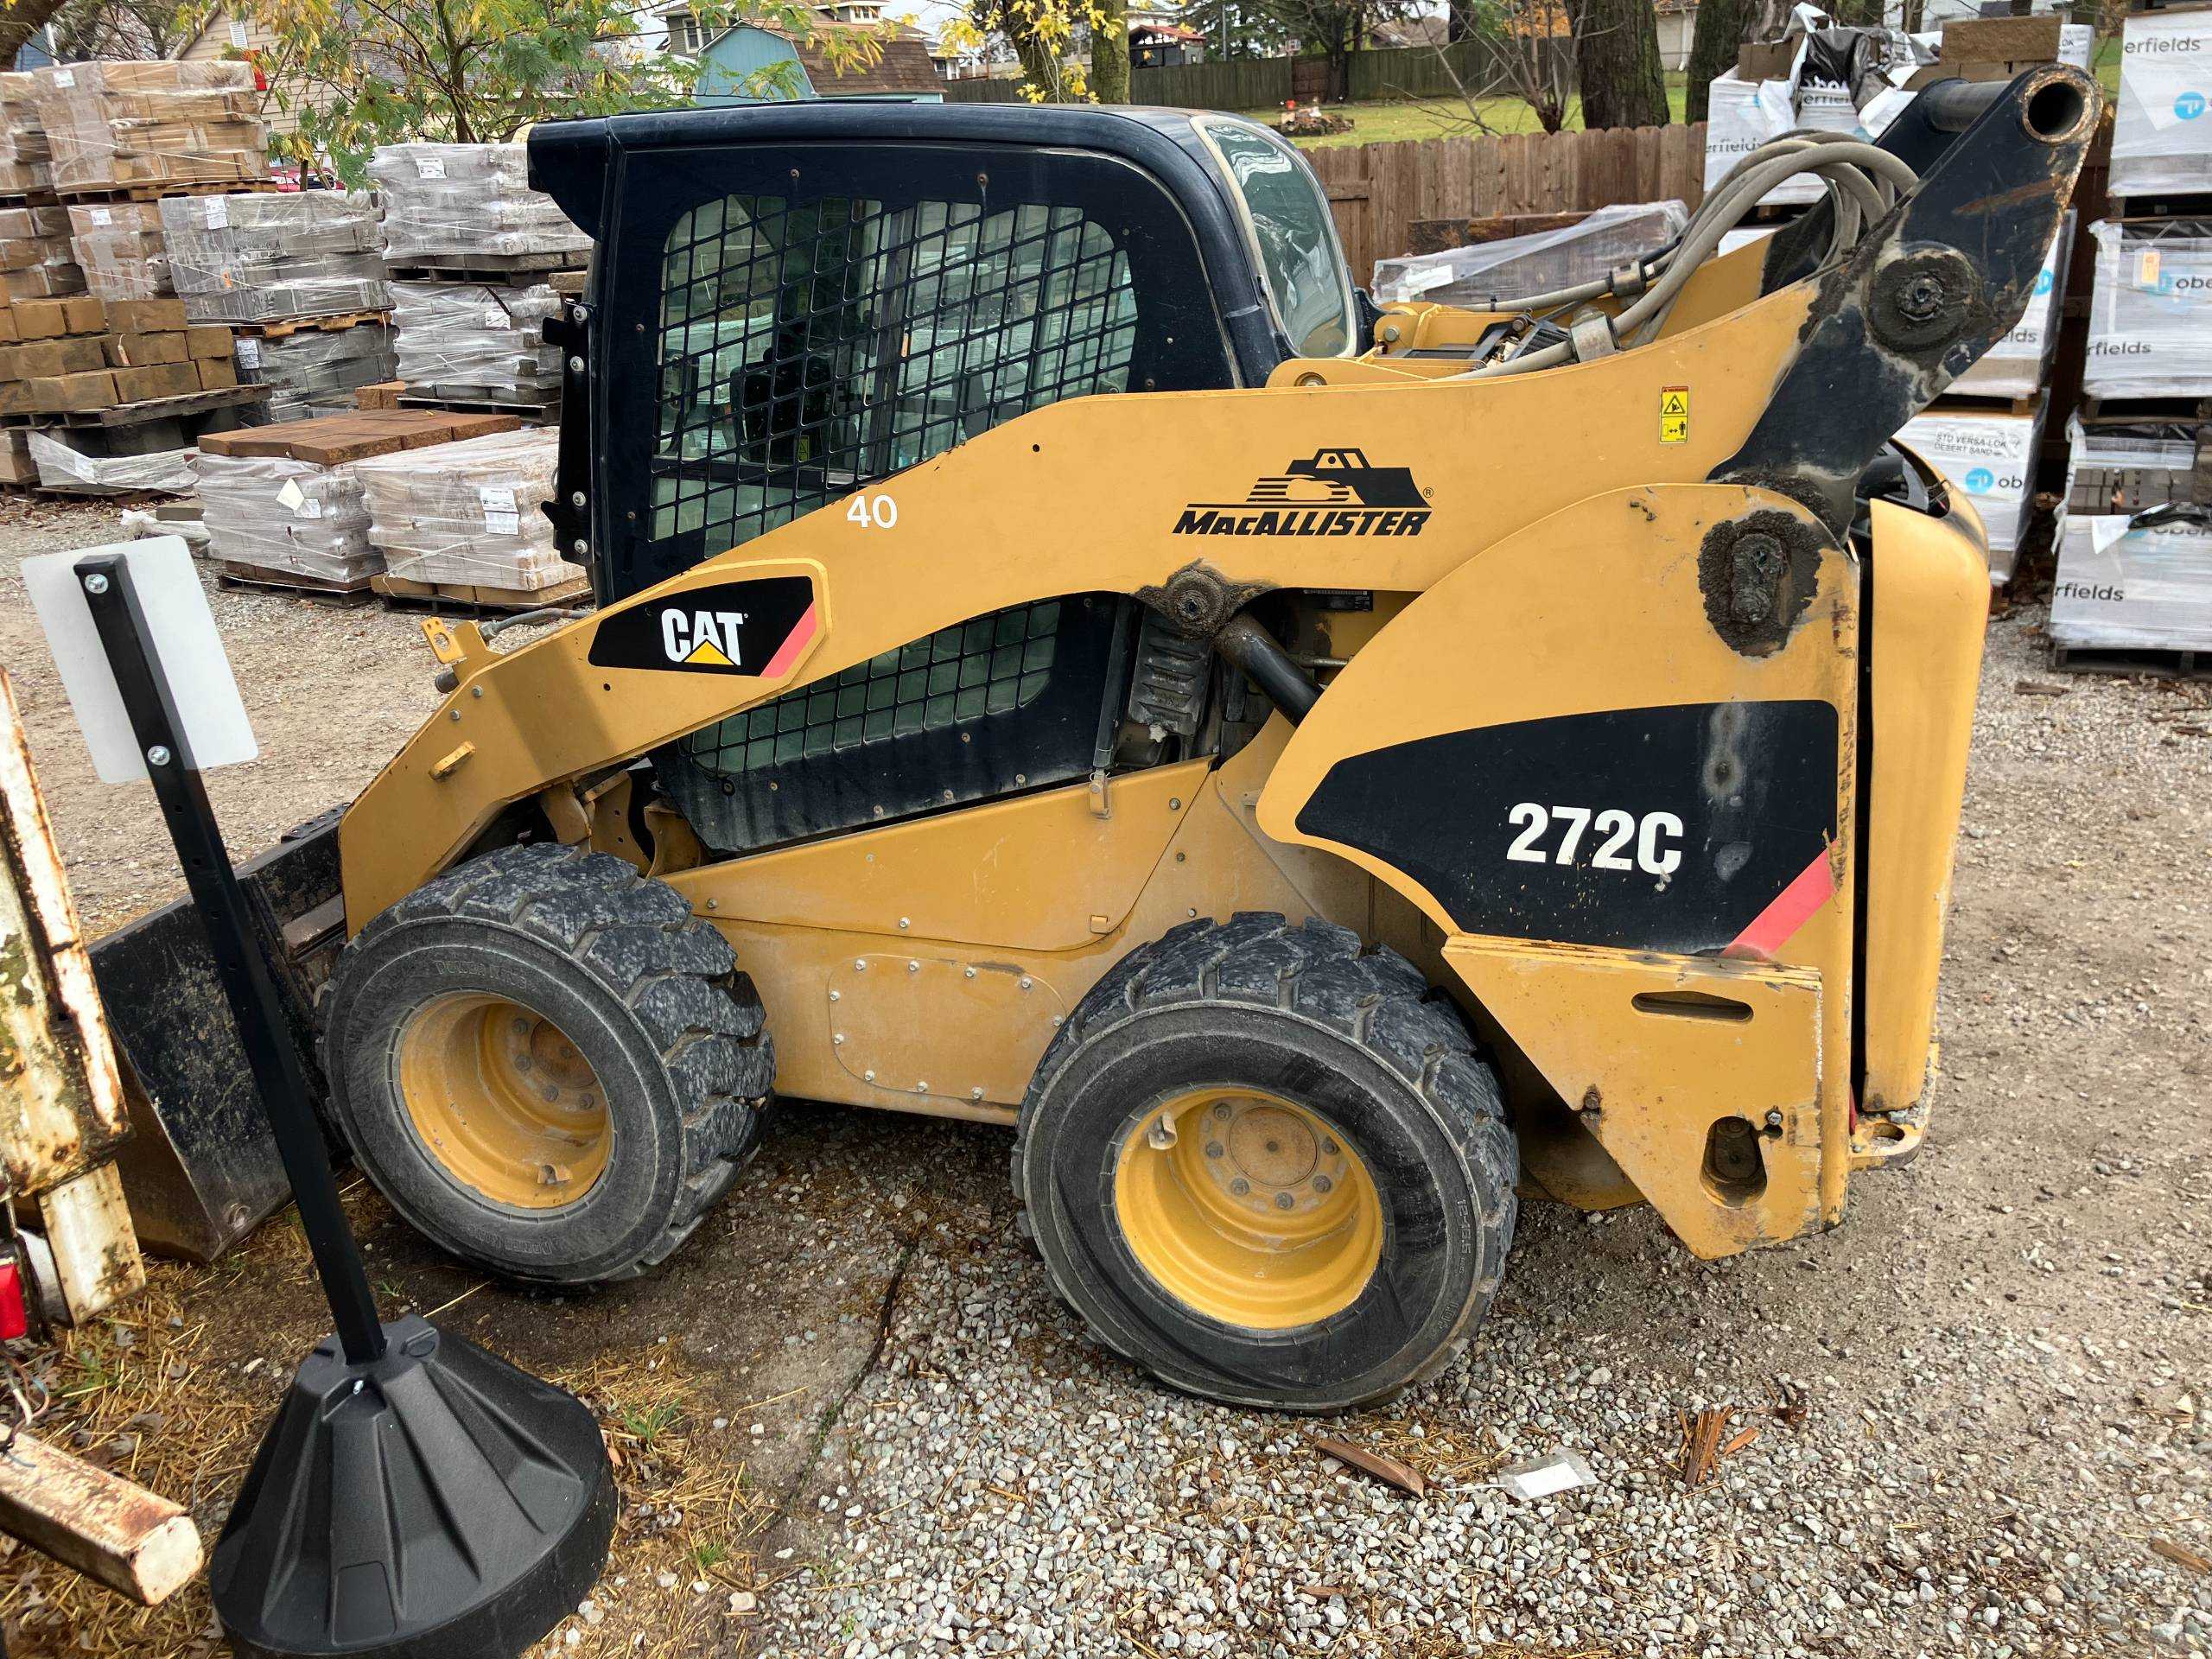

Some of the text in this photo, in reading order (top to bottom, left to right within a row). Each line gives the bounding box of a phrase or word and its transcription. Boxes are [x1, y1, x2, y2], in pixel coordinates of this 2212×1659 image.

[2124, 37, 2201, 54] erfields
[1705, 137, 1760, 154] erfield
[1999, 474, 2023, 489] ob
[846, 494, 898, 529] 40
[2055, 582, 2126, 602] rfields
[661, 608, 744, 666] CAT
[1506, 802, 1684, 875] 272C
